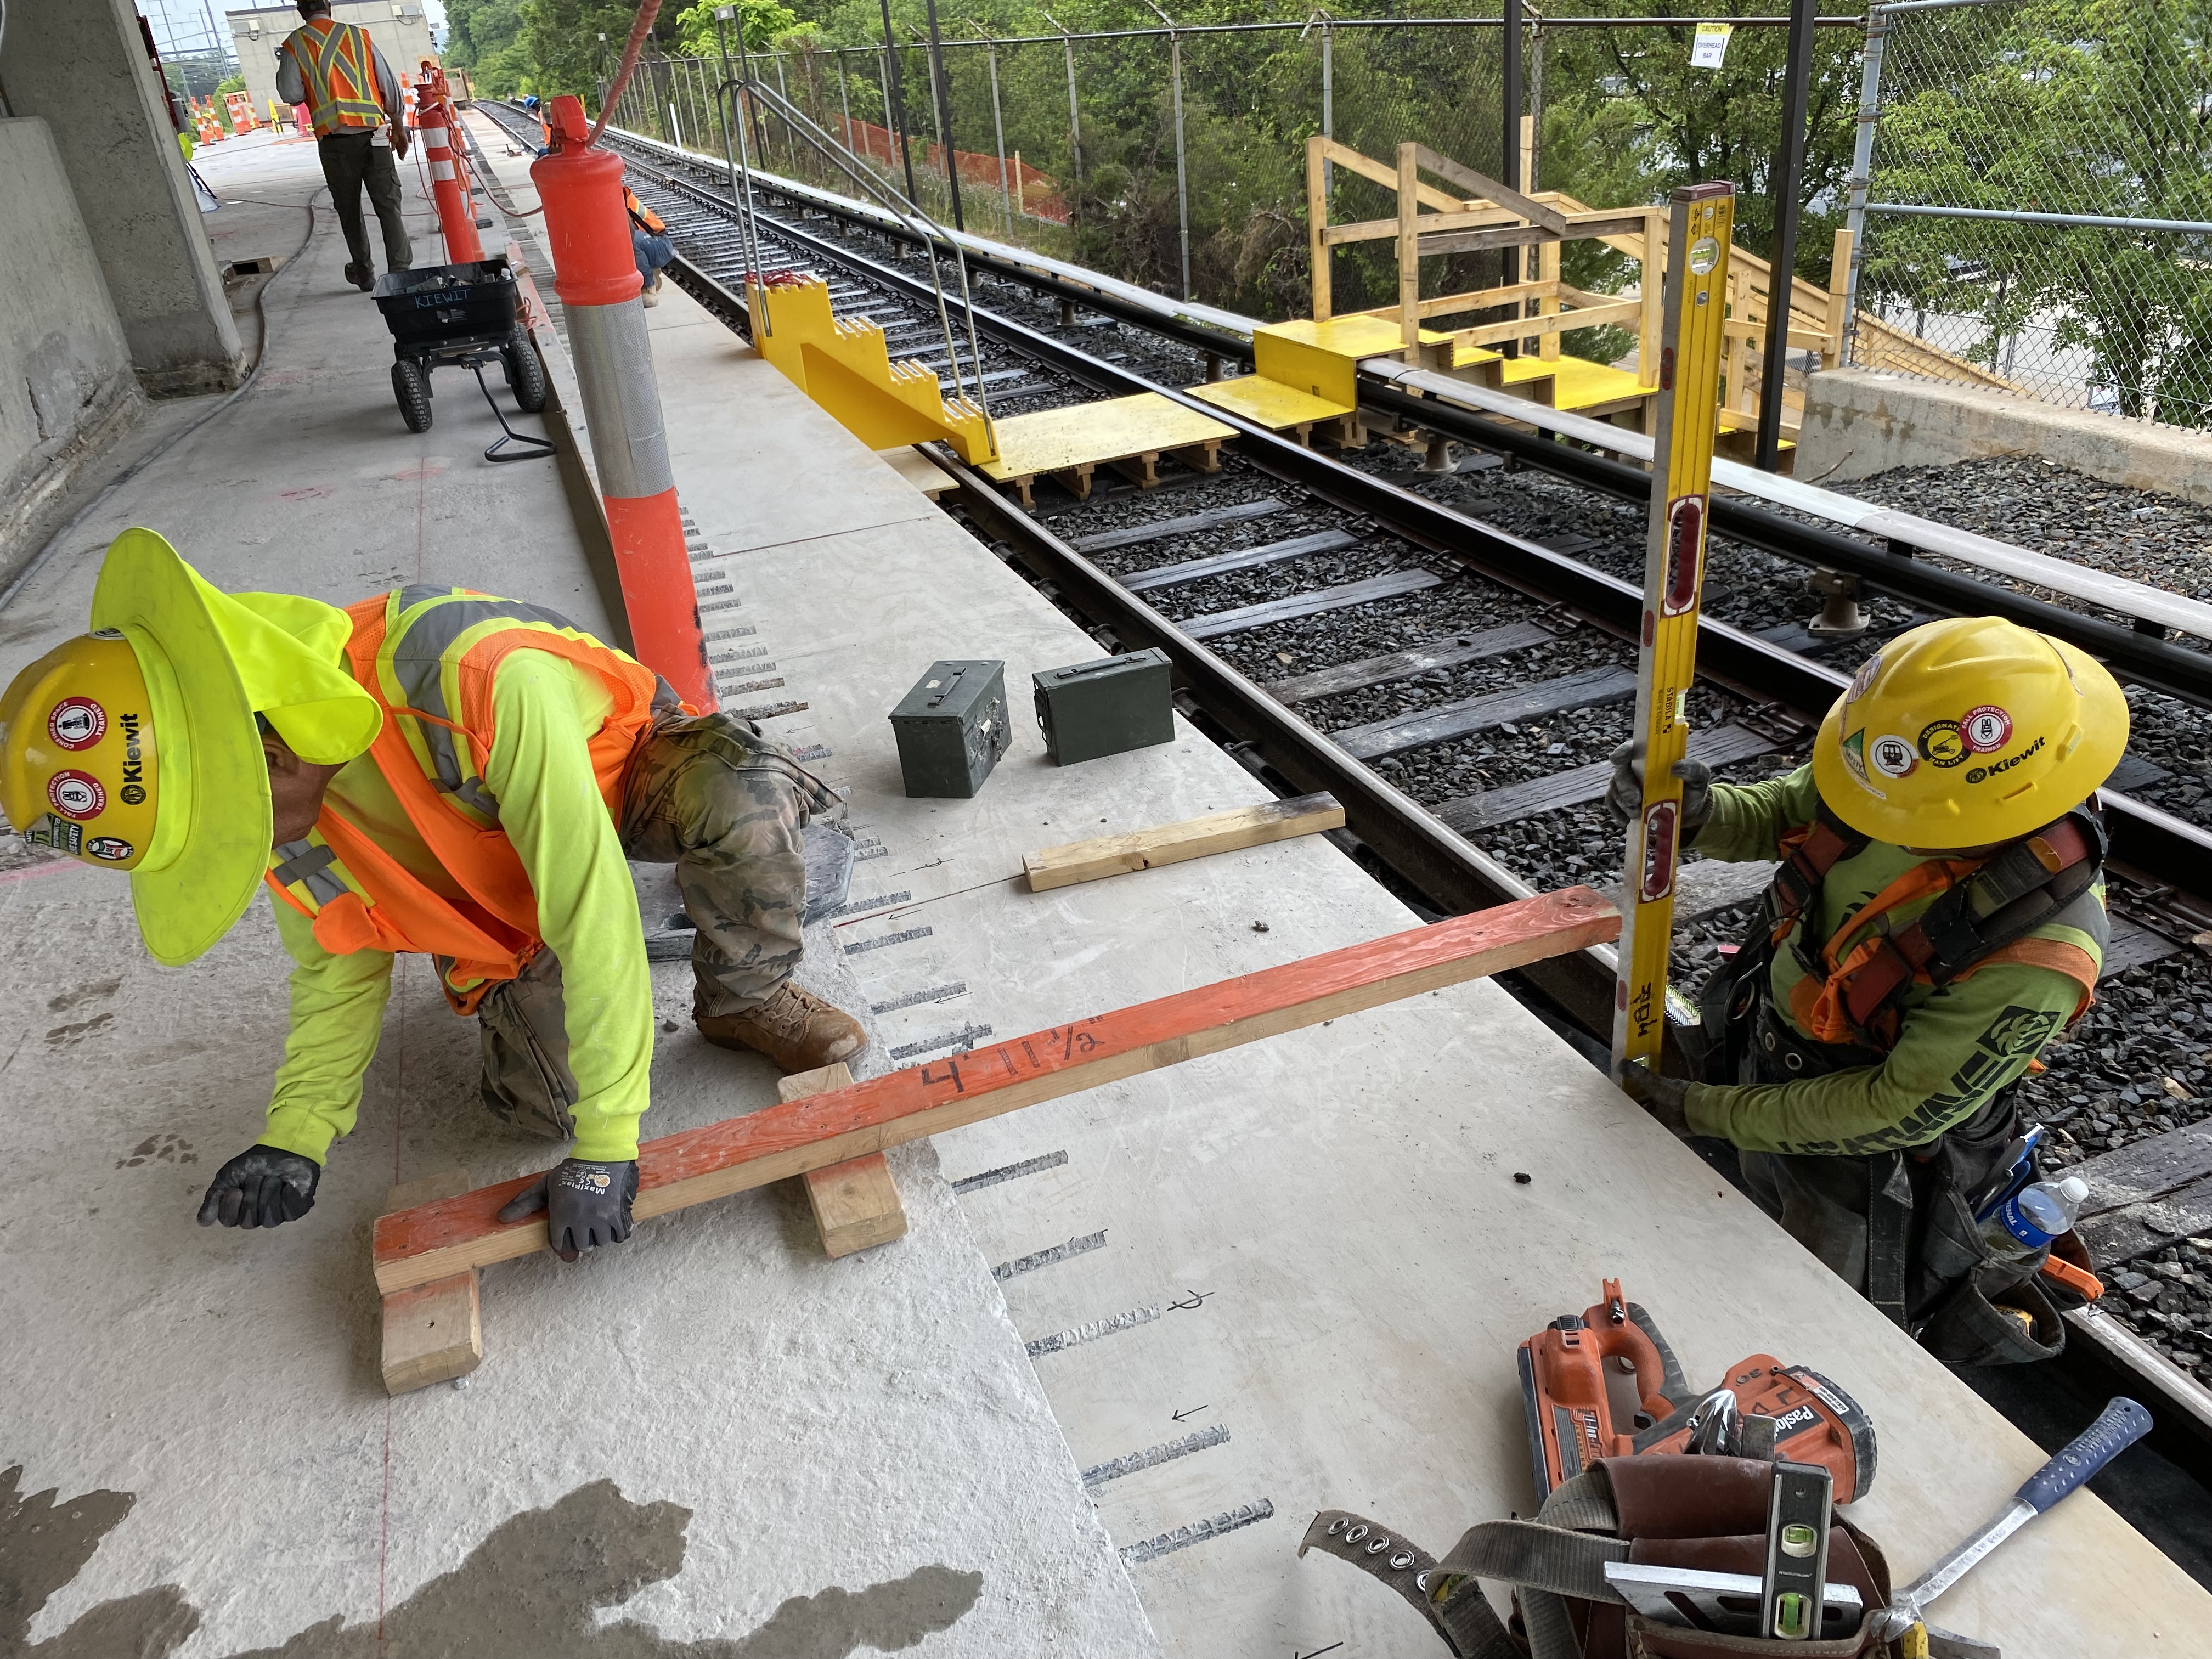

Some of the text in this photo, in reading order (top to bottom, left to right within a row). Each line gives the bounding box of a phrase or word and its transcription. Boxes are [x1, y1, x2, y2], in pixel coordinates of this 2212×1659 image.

[414, 288, 471, 309] KIEWIT
[1665, 686, 1674, 721] STABILA
[1962, 706, 2011, 729] FALL PROTECTION
[49, 701, 75, 749] CONFINED SPACE
[90, 703, 105, 736] TRAINED
[120, 713, 143, 783] Kiewit
[1948, 754, 1964, 765] LIFT
[1972, 743, 2001, 753] TRAINED
[1988, 735, 2046, 777] Kiewit
[49, 772, 70, 807] PROTECTION
[93, 782, 105, 810] TRAINED
[59, 805, 76, 819] FALL
[69, 824, 80, 845] SAFETY
[1775, 1405, 1814, 1437] Paslo
